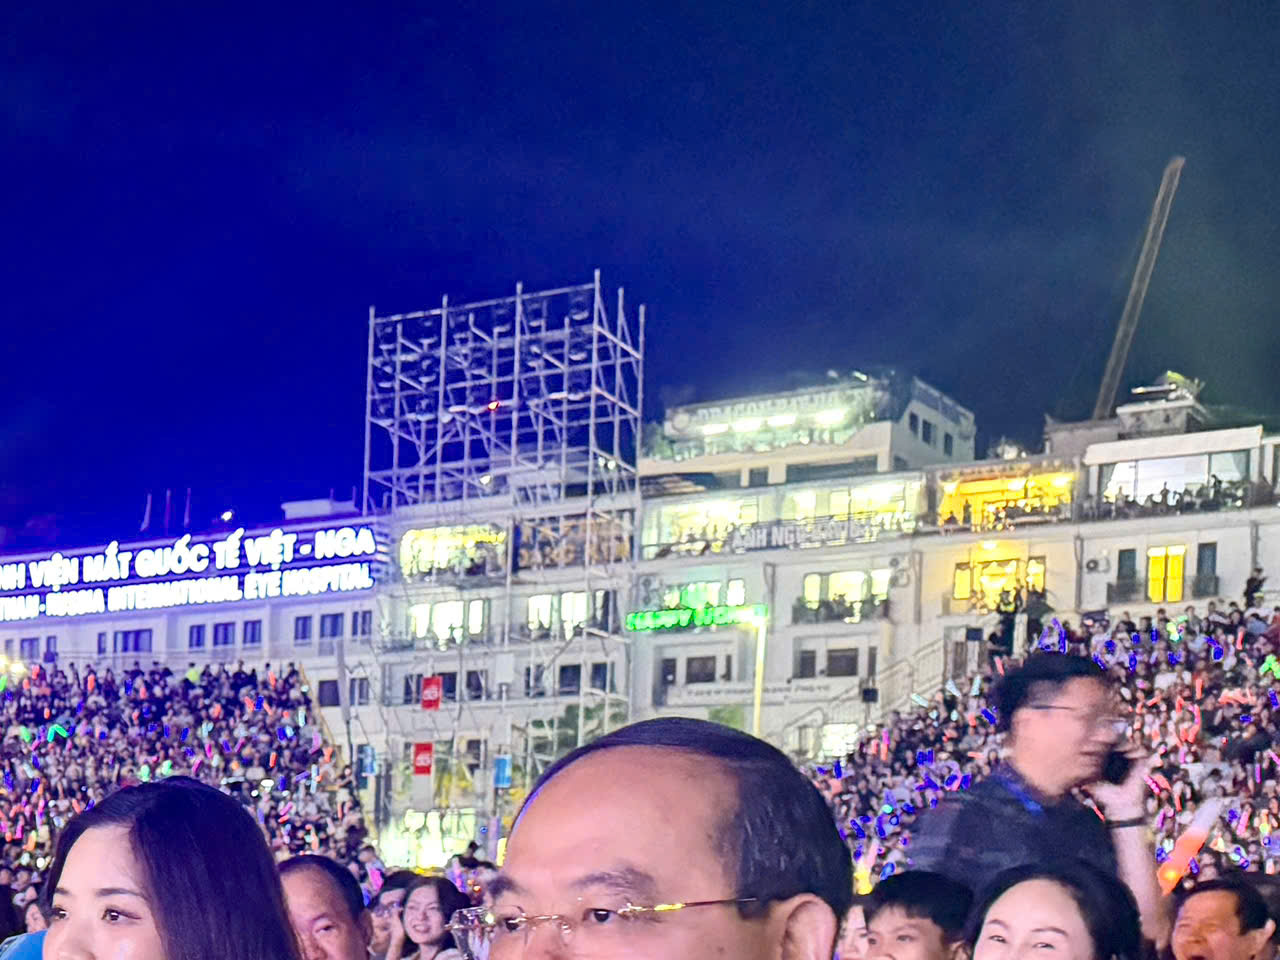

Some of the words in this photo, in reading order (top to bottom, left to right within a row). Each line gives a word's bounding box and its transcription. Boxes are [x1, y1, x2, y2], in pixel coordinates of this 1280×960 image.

[29, 552, 79, 592] VIỆN
[135, 534, 209, 578] QUỐC
[213, 527, 245, 570] TẾ
[244, 528, 298, 571] VIỆT
[314, 526, 376, 560] NGA
[244, 570, 282, 600] EYE
[282, 562, 375, 597] HOSPITAL
